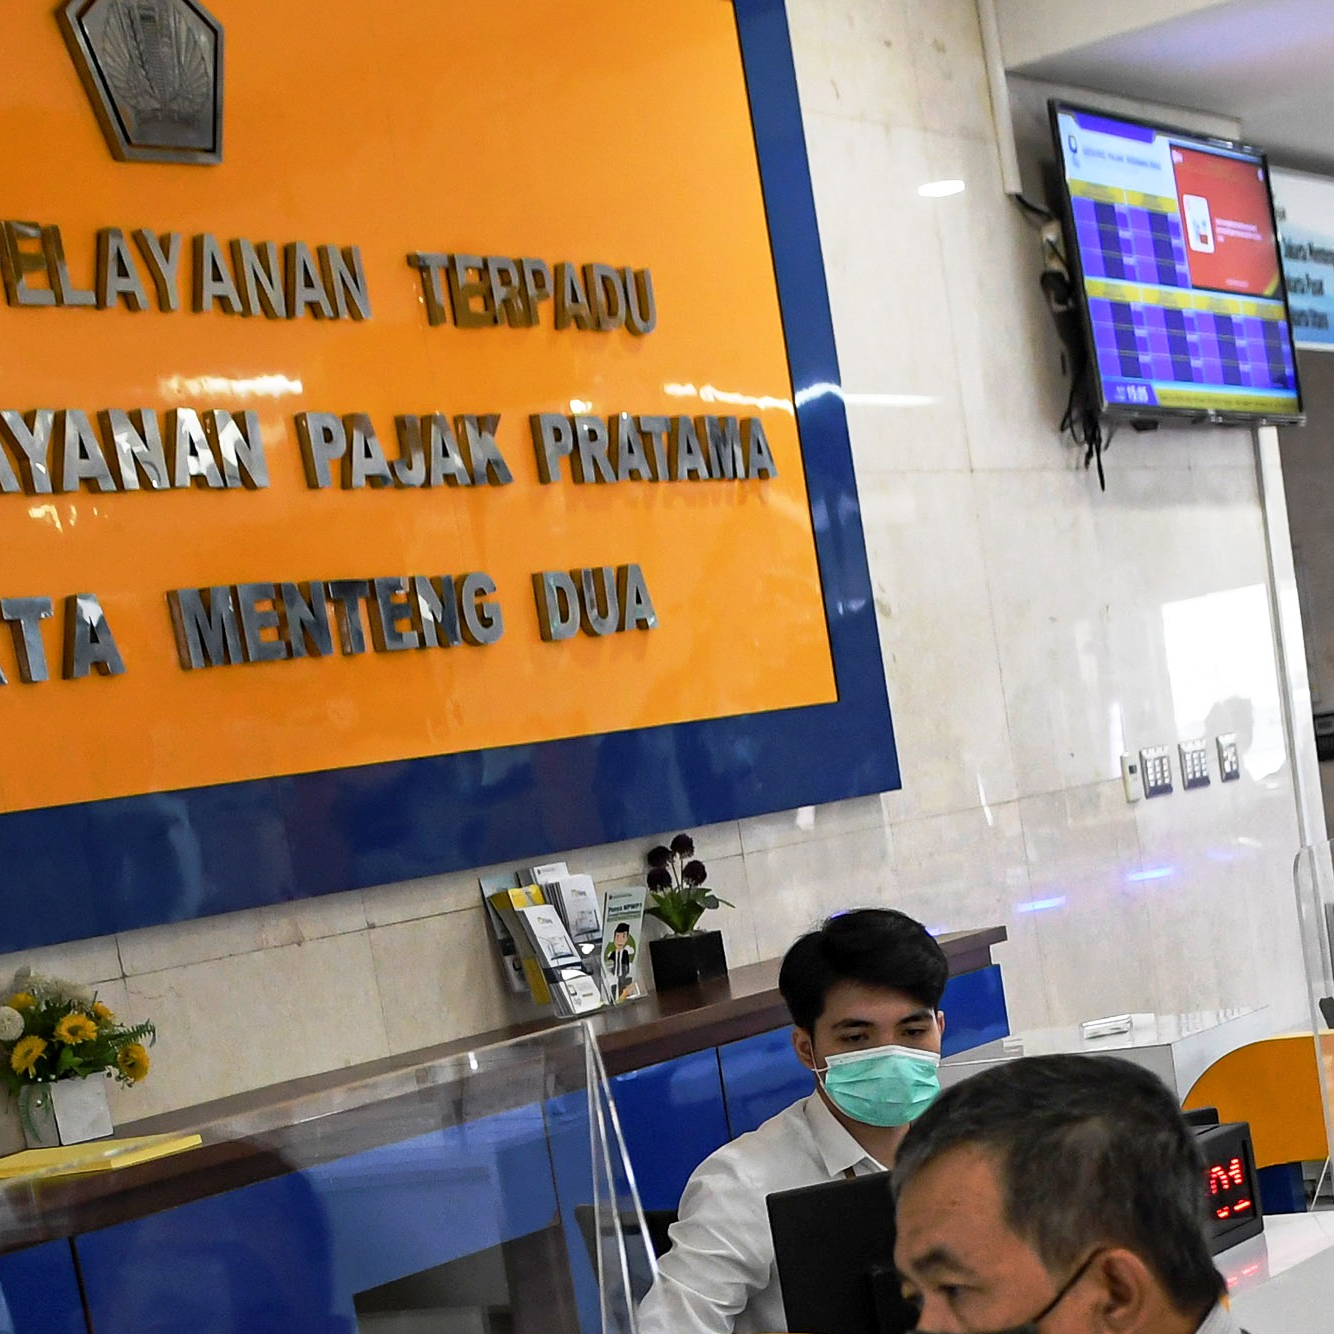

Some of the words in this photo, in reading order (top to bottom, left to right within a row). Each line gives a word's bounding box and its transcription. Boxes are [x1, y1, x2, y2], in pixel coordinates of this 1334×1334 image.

[407, 250, 659, 336] TERPADU
[296, 410, 515, 490] PAJAK
[529, 413, 778, 487] PRATAMA
[166, 571, 504, 671] MENTENG
[533, 563, 658, 644] DUA
